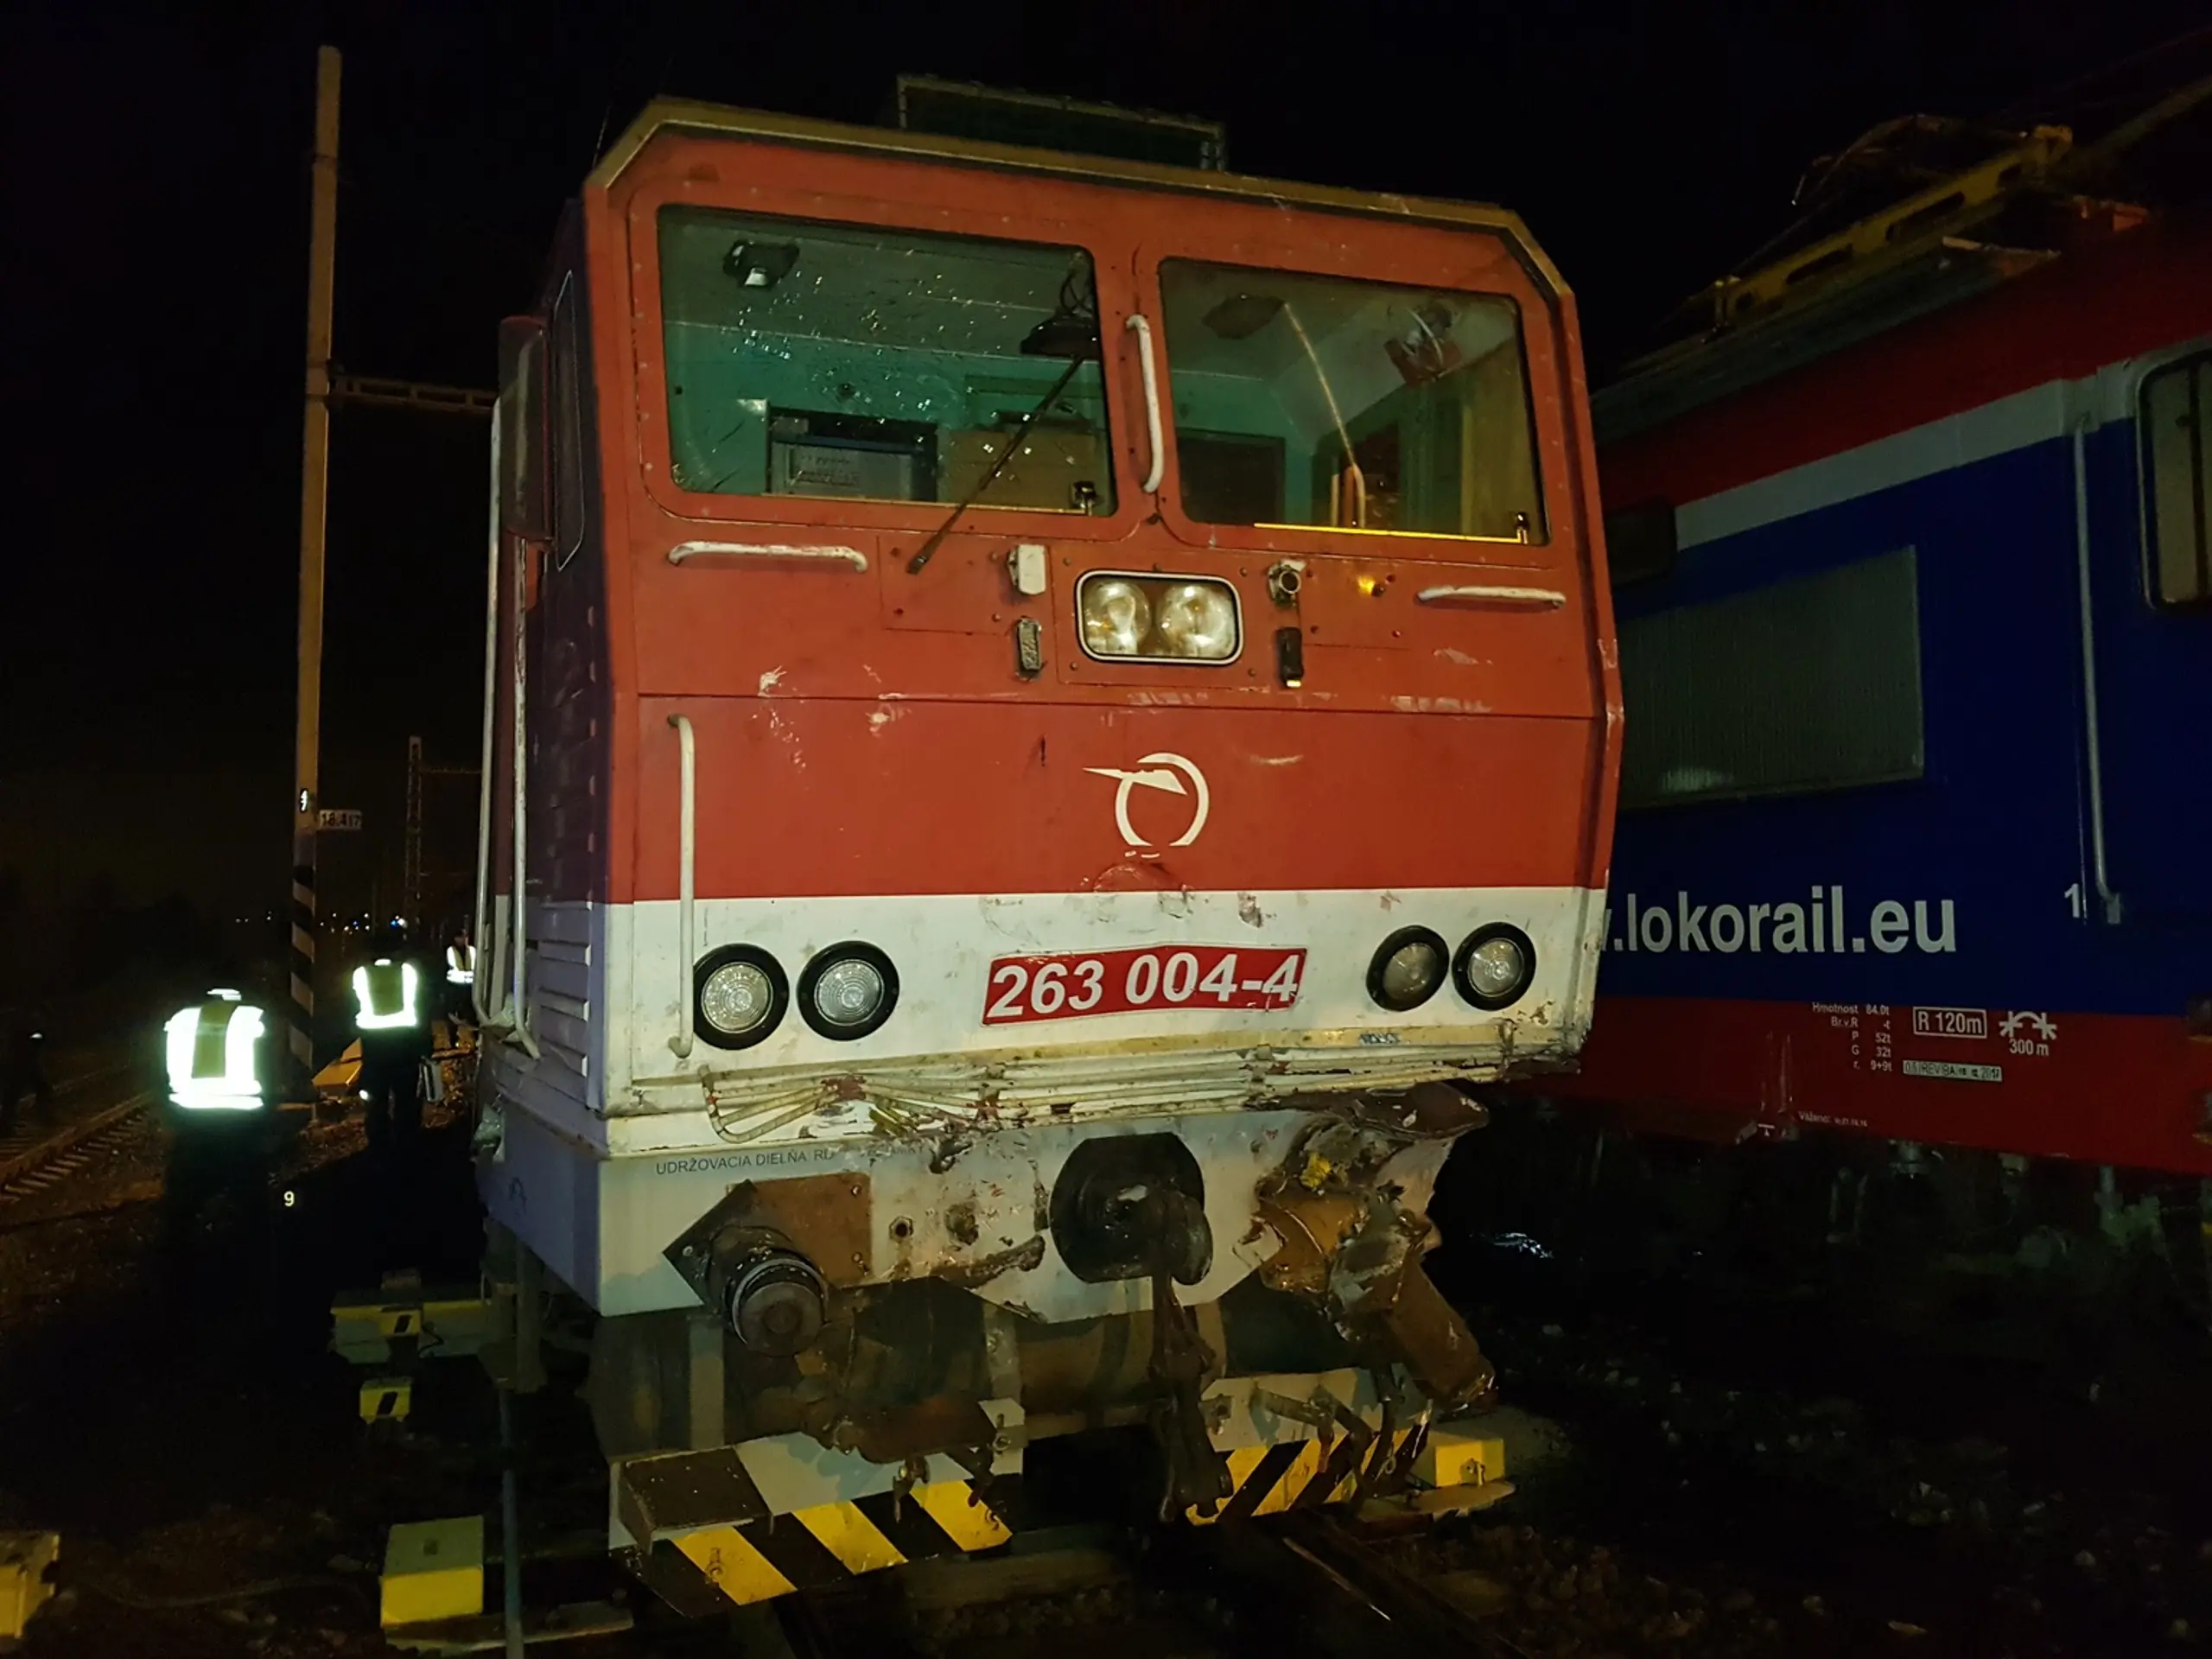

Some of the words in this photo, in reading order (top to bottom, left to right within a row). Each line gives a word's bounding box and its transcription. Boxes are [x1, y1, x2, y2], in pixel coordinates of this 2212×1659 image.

[986, 958, 1106, 1019] 263
[1124, 950, 1300, 1005] 004-4
[1811, 1001, 1859, 1014] Hmotnost
[1917, 1010, 1929, 1031] R
[1936, 1011, 1983, 1034] 120m
[1851, 1029, 1859, 1040] P
[1851, 1044, 1860, 1056] G
[2008, 1038, 2034, 1056] 300
[2035, 1042, 2050, 1057] m
[656, 1154, 752, 1175] UDRŽOVACIA
[756, 1148, 807, 1166] DIELŇA
[283, 1189, 296, 1208] 9
